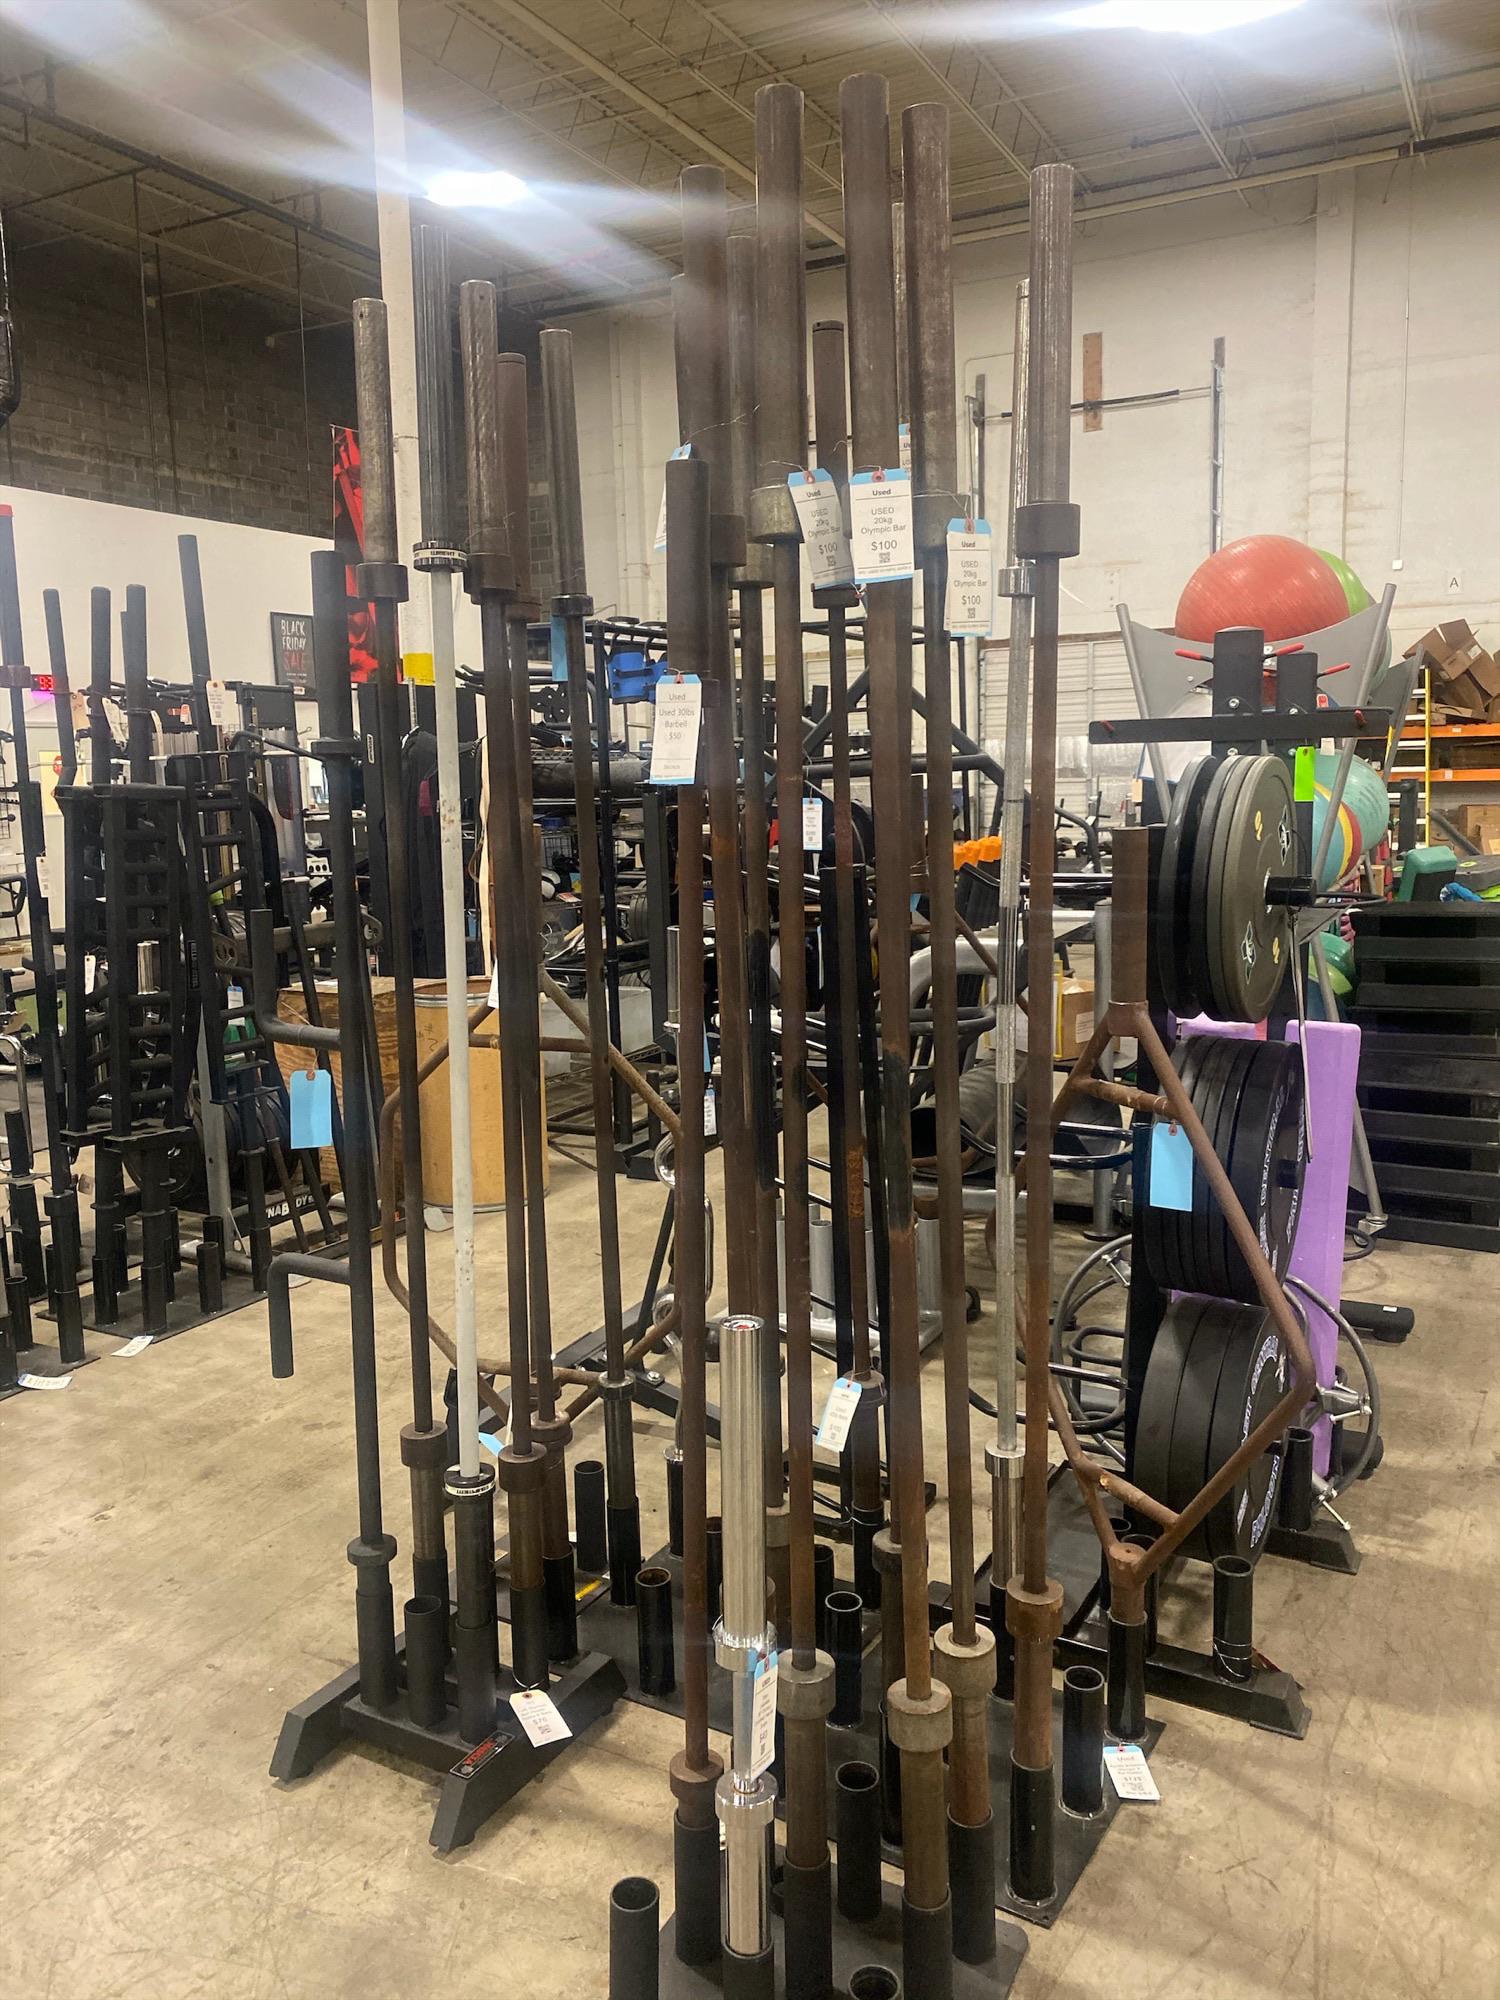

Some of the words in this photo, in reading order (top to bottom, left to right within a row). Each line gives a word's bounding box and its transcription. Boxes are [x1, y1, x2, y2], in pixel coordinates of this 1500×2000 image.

[806, 490, 821, 498] Used
[872, 488, 891, 496] Used
[871, 507, 894, 516] USED
[874, 516, 893, 525] 20kg
[860, 524, 891, 535] Olympic
[893, 523, 906, 532] Bar
[818, 543, 838, 555] $100
[871, 539, 898, 551] $100
[961, 560, 979, 568] USED
[954, 580, 976, 588] Olympic
[1449, 577, 1459, 588] A
[961, 594, 981, 606] $100
[281, 619, 306, 636] BLACK
[282, 636, 307, 651] FRIDAY
[283, 651, 305, 672] SALE
[669, 693, 686, 701] Used
[659, 708, 676, 716] Used
[678, 707, 695, 716] 30lbs
[664, 720, 688, 728] Barbell
